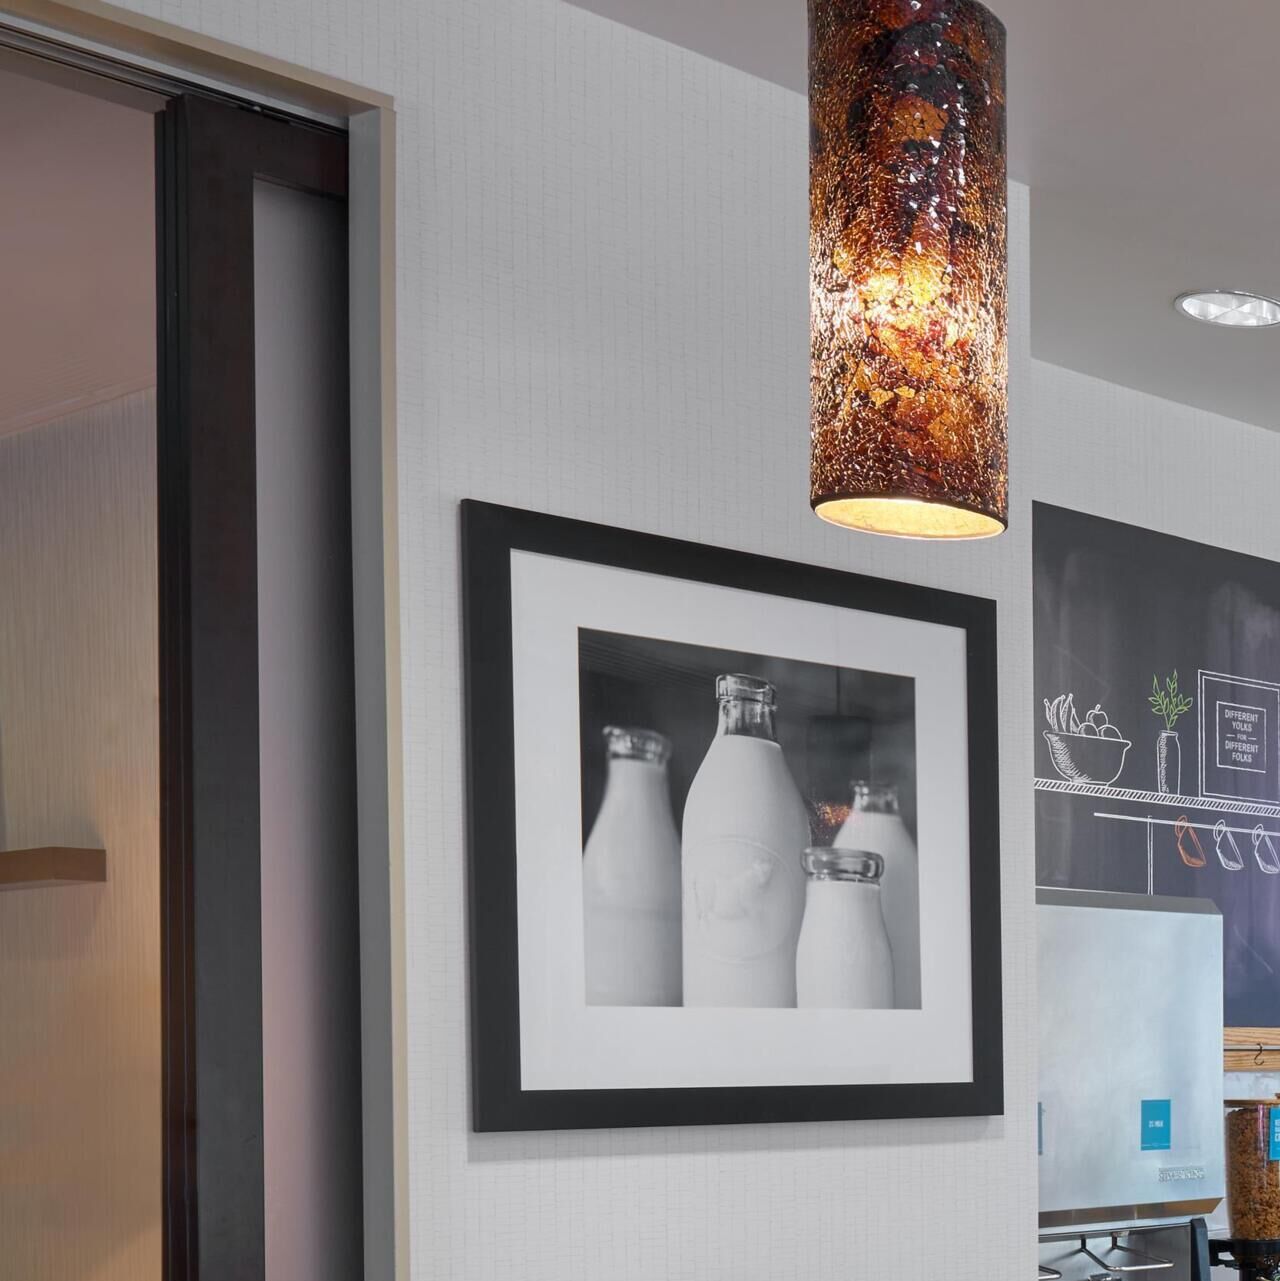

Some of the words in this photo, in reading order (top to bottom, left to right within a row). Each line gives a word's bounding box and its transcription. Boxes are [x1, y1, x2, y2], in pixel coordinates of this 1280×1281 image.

[1224, 709, 1258, 722] DIFFERENT
[1232, 721, 1252, 732] YOLKS
[1225, 740, 1259, 753] DIFFERENT
[1232, 752, 1252, 763] FOLKS
